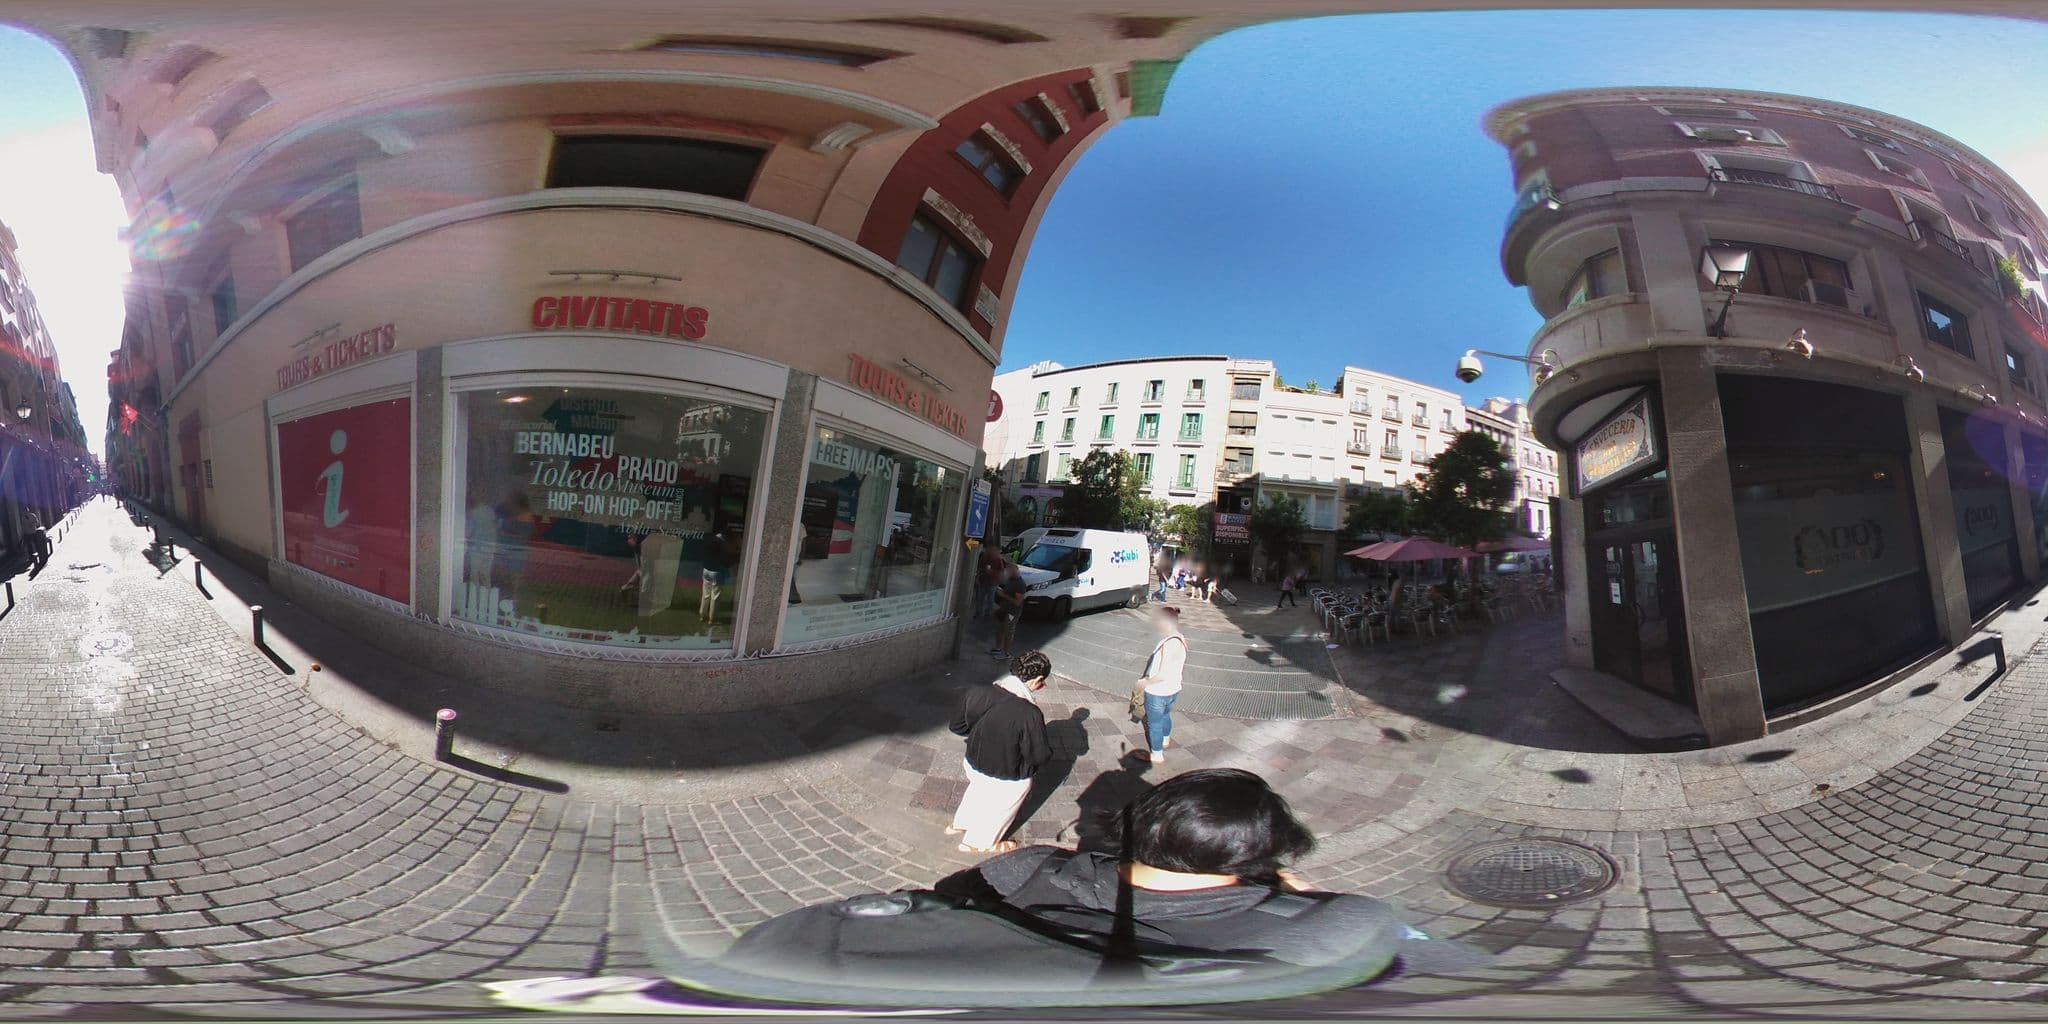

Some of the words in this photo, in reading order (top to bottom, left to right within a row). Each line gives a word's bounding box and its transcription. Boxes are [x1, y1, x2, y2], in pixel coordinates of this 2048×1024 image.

[532, 296, 708, 339] CIVITATIS
[277, 356, 310, 389] TOURS
[311, 356, 321, 374] &
[324, 323, 396, 368] TICKETS
[848, 352, 908, 405] TOURS
[908, 390, 921, 412] &
[923, 392, 968, 436] TICKETS
[514, 431, 616, 460] BERNABEU
[816, 439, 849, 466] FREE
[850, 447, 894, 480] MAPS
[530, 458, 615, 492] Toledo
[616, 455, 680, 485] PRADO
[613, 479, 676, 498] Museum
[547, 491, 606, 516] HOP-ON
[609, 496, 675, 521] HOP-OFF
